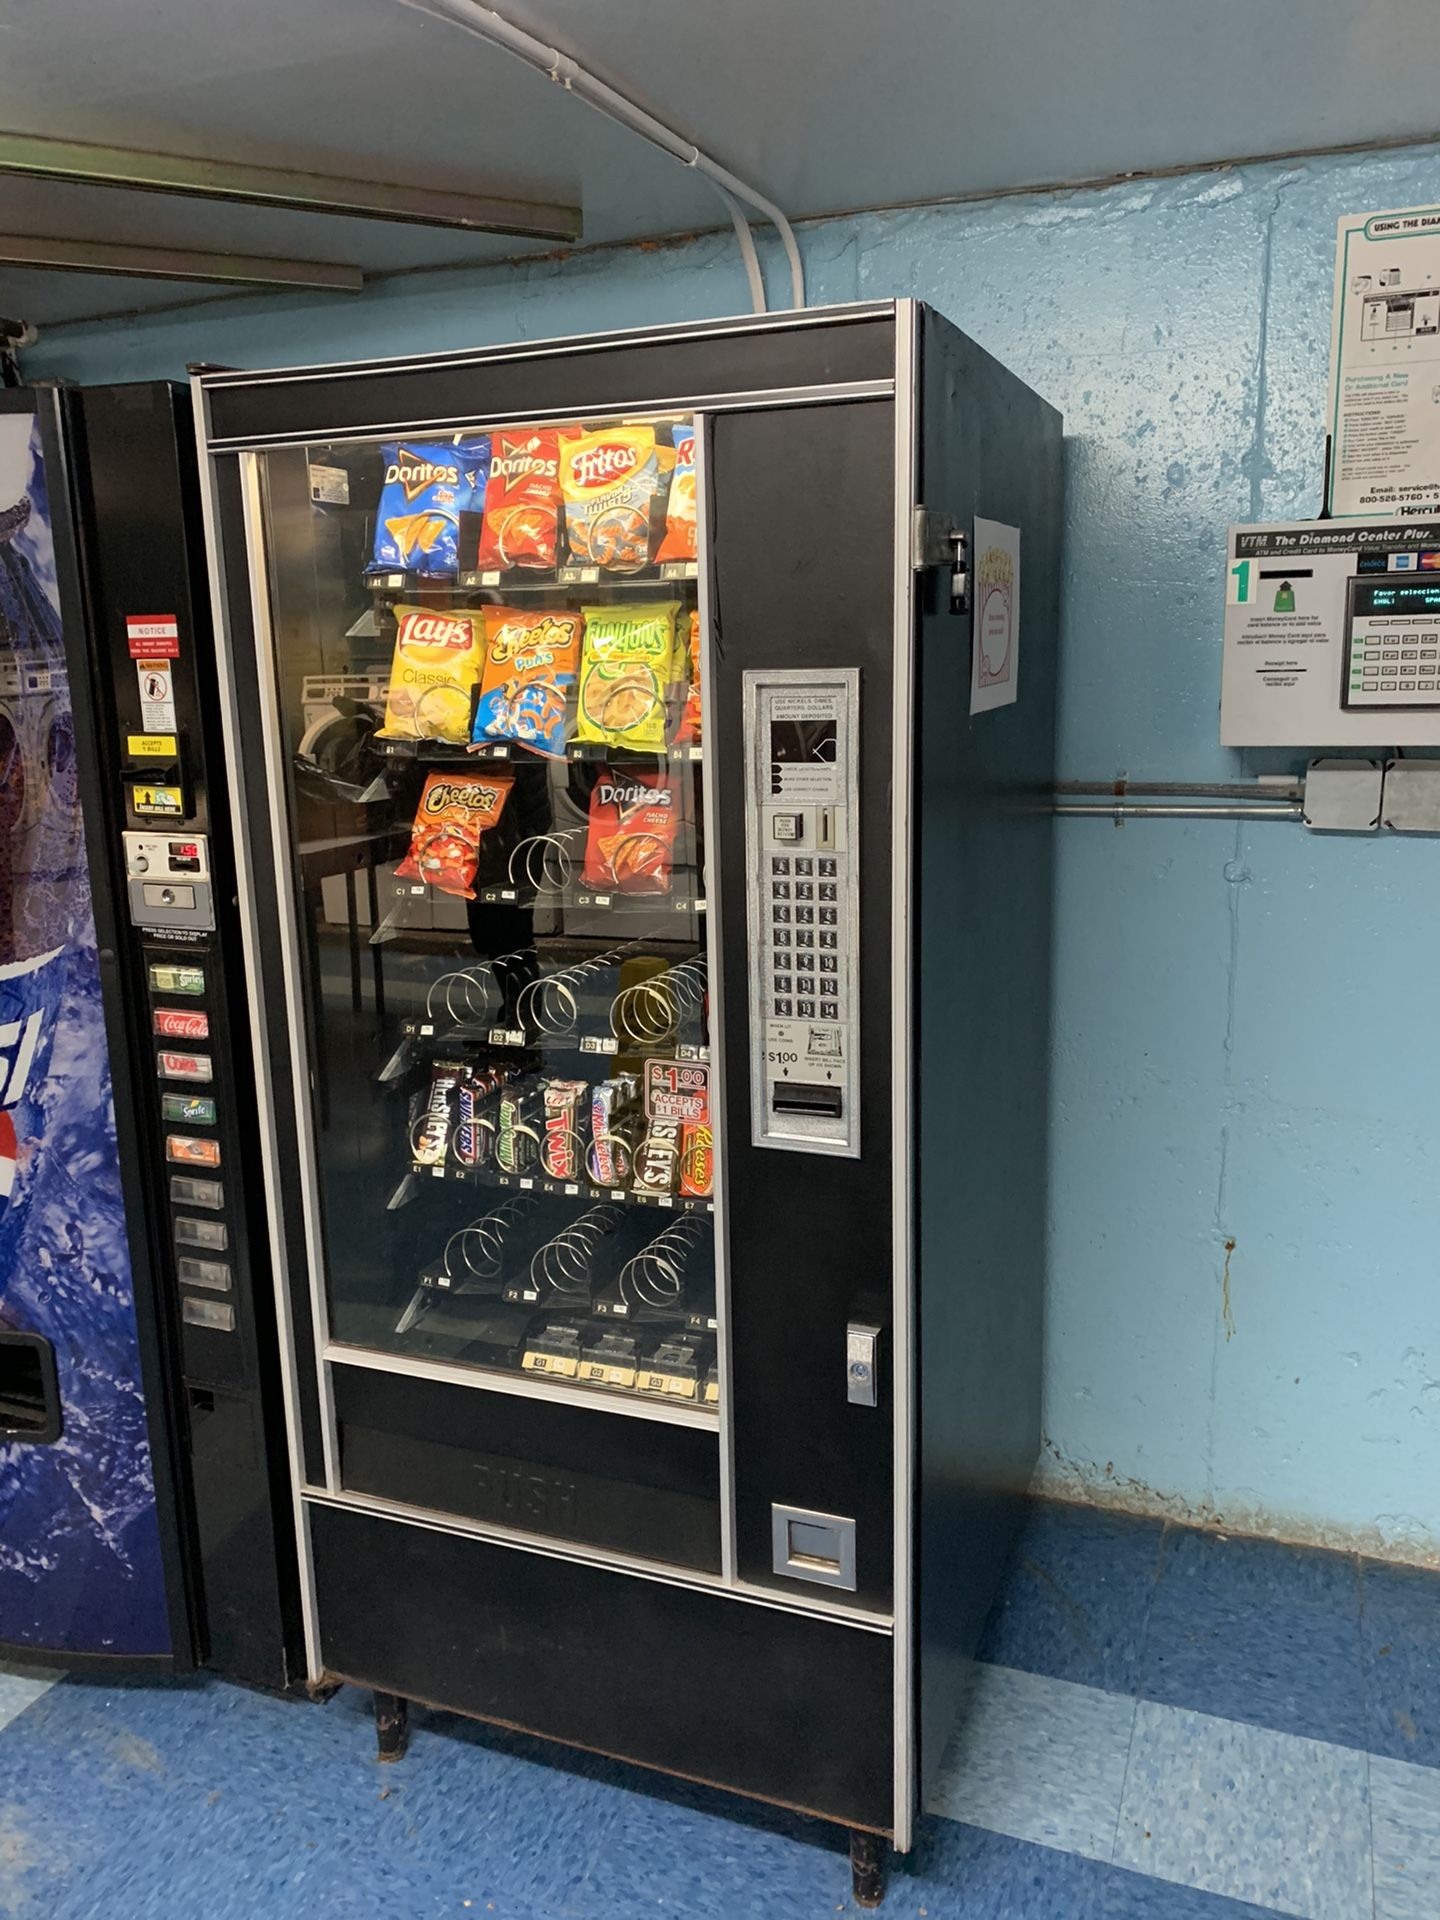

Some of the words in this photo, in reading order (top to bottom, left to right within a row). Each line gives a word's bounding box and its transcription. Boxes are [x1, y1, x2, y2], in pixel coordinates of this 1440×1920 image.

[1374, 221, 1401, 232] USING
[1402, 219, 1419, 229] THE
[1345, 384, 1354, 392] Or
[1355, 382, 1390, 390] Additional
[1391, 379, 1409, 388] Card
[489, 456, 559, 479] Doritos
[569, 447, 638, 488] Fritos
[384, 463, 459, 486] Doritos
[1370, 486, 1396, 494] Email:
[1241, 535, 1268, 548] VTM
[1275, 535, 1296, 546] The
[1300, 531, 1356, 546] Diamond
[1357, 530, 1402, 542] Center
[1403, 528, 1430, 541] Plus
[1255, 549, 1269, 557] ATM
[1283, 547, 1302, 555] Credit
[1326, 545, 1363, 554] MoneyCard
[1382, 543, 1406, 551] Transfer
[1407, 542, 1419, 550] and
[372, 578, 381, 587] A1
[466, 576, 476, 586] A2
[1231, 560, 1251, 603] 1
[1373, 589, 1397, 597] Favor
[138, 626, 167, 635] NOTICE
[491, 616, 574, 663] Cheetos
[402, 668, 457, 686] Classic
[426, 783, 498, 814] Cheetos
[600, 784, 672, 805] Doritos
[646, 811, 669, 819] NACHO
[642, 816, 668, 825] CHEESE
[396, 887, 406, 896] C1
[485, 892, 496, 902] C2
[578, 896, 590, 905] C3
[675, 902, 688, 911] C4
[157, 928, 182, 936] SELECTION
[406, 1025, 416, 1033] D1
[493, 1034, 504, 1043] D2
[585, 1041, 596, 1050] D3
[680, 1049, 692, 1058] D4
[768, 1051, 798, 1064] $1.00
[654, 1094, 703, 1109] ACCEPTS
[183, 1104, 206, 1118] Sprite
[670, 1105, 701, 1119] BILLS
[590, 1189, 600, 1198] E5
[685, 1201, 695, 1210] E7
[424, 1277, 433, 1285] F1
[508, 1291, 518, 1300] F2
[597, 1304, 607, 1313] F3
[690, 1316, 701, 1325] F4
[536, 1359, 546, 1367] G1
[592, 1368, 602, 1377] G2
